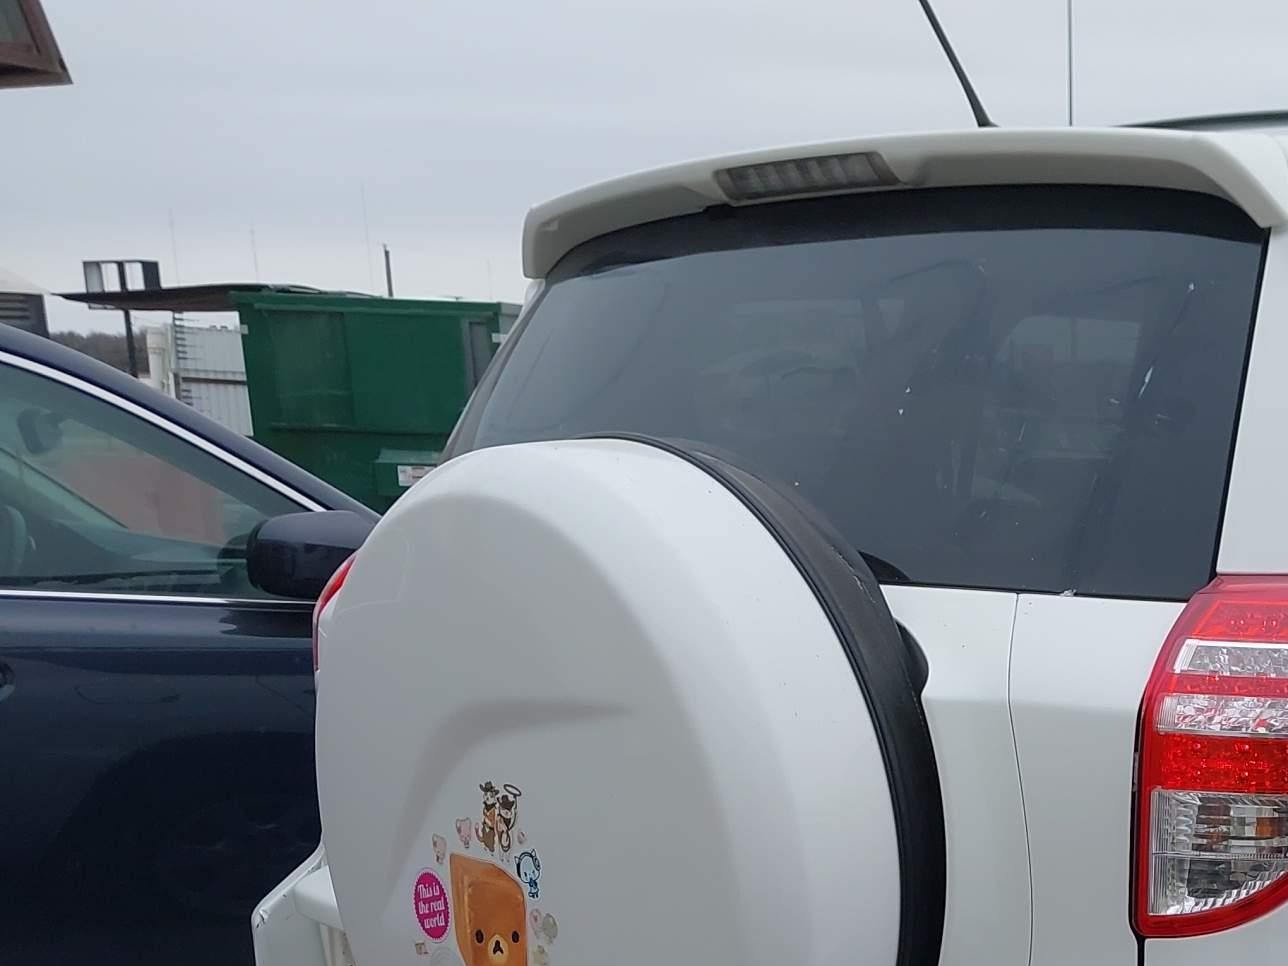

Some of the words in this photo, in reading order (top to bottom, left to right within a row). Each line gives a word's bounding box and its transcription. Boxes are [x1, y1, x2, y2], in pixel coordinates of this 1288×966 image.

[417, 883, 433, 899] This
[433, 882, 440, 896] is
[418, 901, 430, 915] the
[430, 897, 445, 912] real
[424, 912, 446, 929] world
